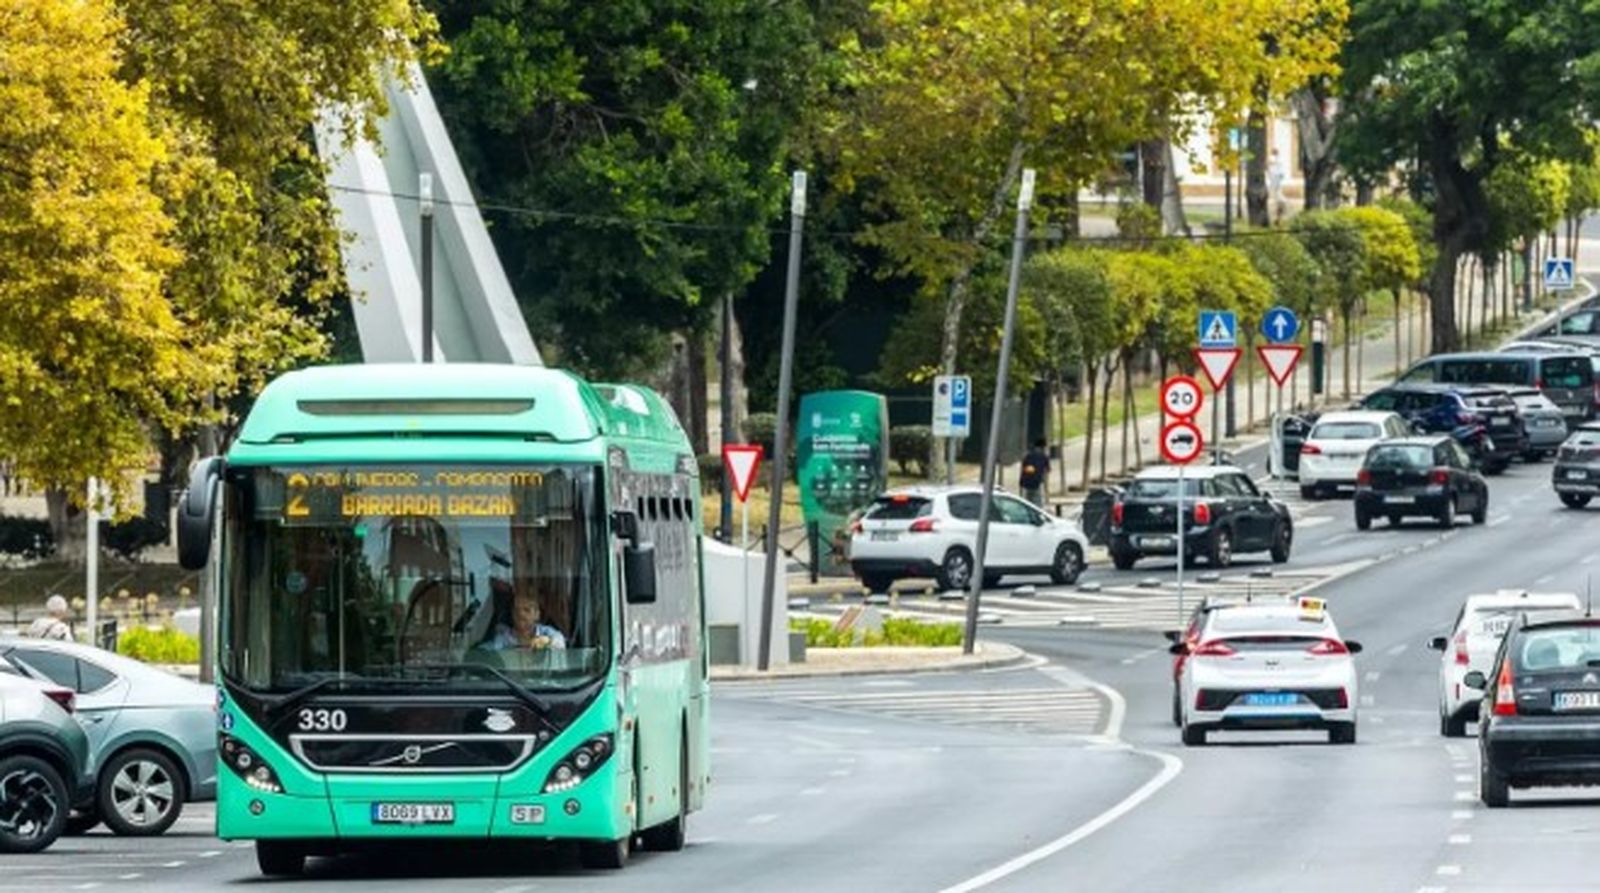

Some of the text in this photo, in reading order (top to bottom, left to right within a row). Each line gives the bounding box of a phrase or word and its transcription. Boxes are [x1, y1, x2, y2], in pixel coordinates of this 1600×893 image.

[1170, 391, 1193, 406] 20
[287, 472, 310, 516] 2
[341, 495, 441, 516] BARRIADA
[298, 708, 347, 731] 330
